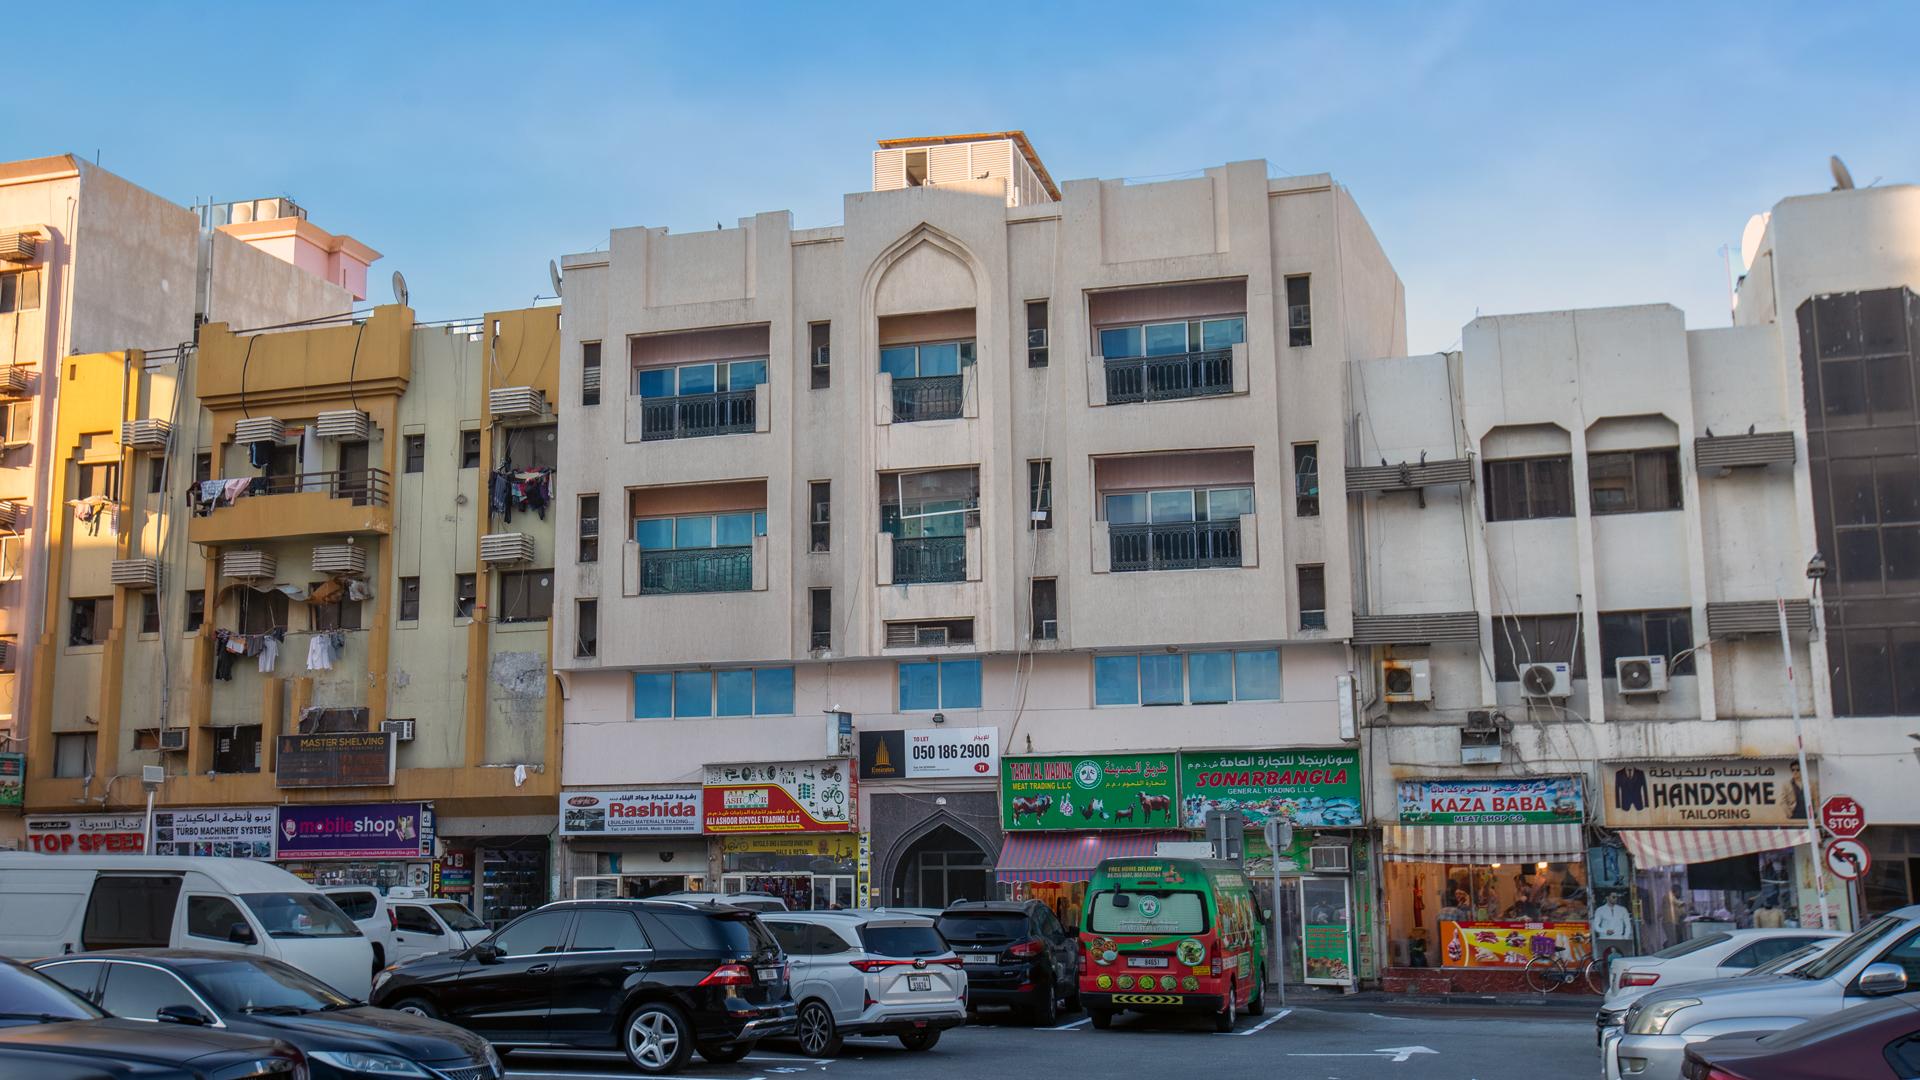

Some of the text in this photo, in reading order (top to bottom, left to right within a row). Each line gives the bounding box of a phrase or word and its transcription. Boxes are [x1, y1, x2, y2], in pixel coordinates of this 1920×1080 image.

[301, 736, 384, 748] MASTER SHELVING
[912, 743, 990, 760] 050 186 2900
[1219, 756, 1254, 767] العامة
[1257, 756, 1294, 768] للتجارة
[1011, 763, 1033, 780] TARIK
[1034, 762, 1043, 780] AL
[1044, 761, 1073, 780] MADINA
[1103, 760, 1142, 777] المدينة
[1143, 761, 1168, 777] طريق
[1648, 766, 1776, 780] هاندسام للخياطة
[1195, 768, 1347, 788] SONARBANGLA
[1029, 782, 1056, 790] TRADING
[1227, 787, 1262, 795] GENERAL
[1263, 786, 1296, 795] TRADING
[1653, 782, 1776, 808] HANDSOME
[609, 801, 696, 818] Rashida
[1430, 796, 1547, 813] KAZA BABA
[1829, 801, 1858, 816] قف
[176, 811, 272, 824] تربو لأنظمة الماكينات
[706, 817, 715, 825] ALI
[715, 816, 738, 825] ASHOOR
[738, 816, 761, 824] BICYCLE
[762, 815, 786, 824] TRADING
[1482, 815, 1507, 823] SHOP
[1679, 808, 1750, 820] TAILORING
[1828, 817, 1860, 829] STOP
[176, 825, 272, 836] TURBO MACHINERY SYSTEMS
[29, 832, 145, 854] TOP SPEED
